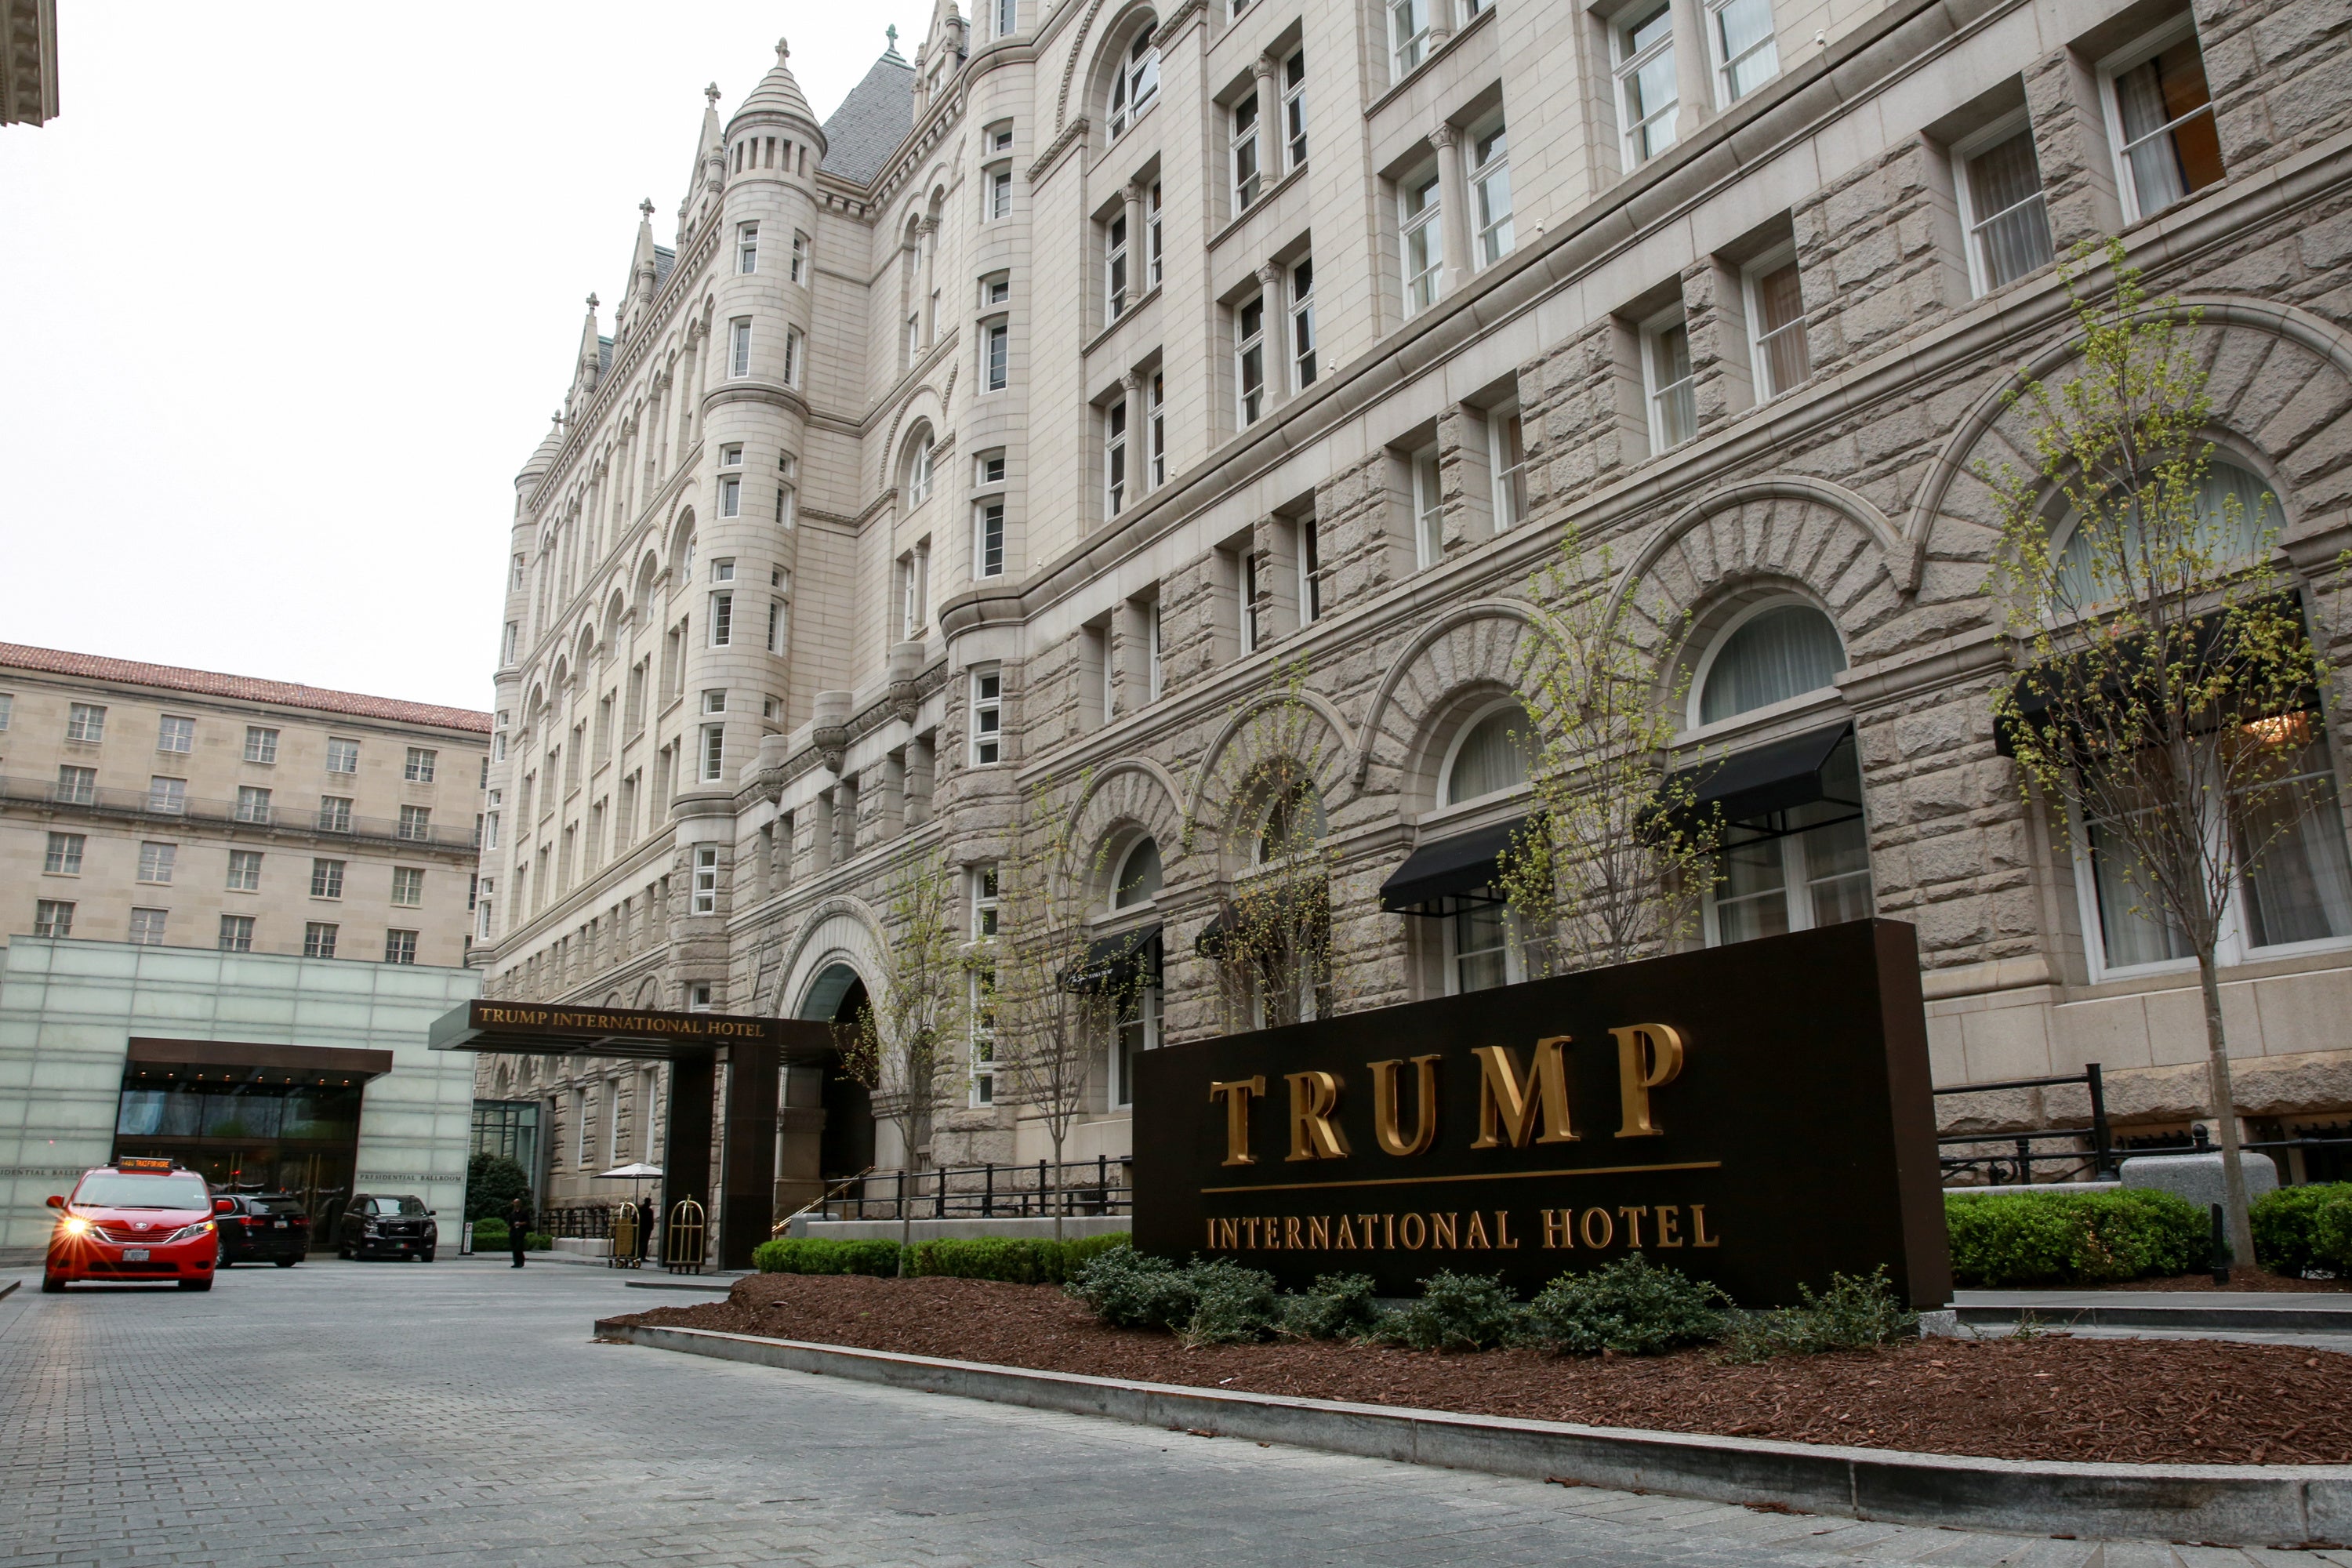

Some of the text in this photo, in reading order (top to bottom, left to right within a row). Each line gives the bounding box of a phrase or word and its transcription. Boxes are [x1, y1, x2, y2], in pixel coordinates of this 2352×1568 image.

[479, 1007, 765, 1037] TRUMP INTERNATIONAL HOTEL
[1210, 1022, 1683, 1166] TRUMP
[1206, 1204, 1719, 1250] INTERNATIONAL HOTEL
